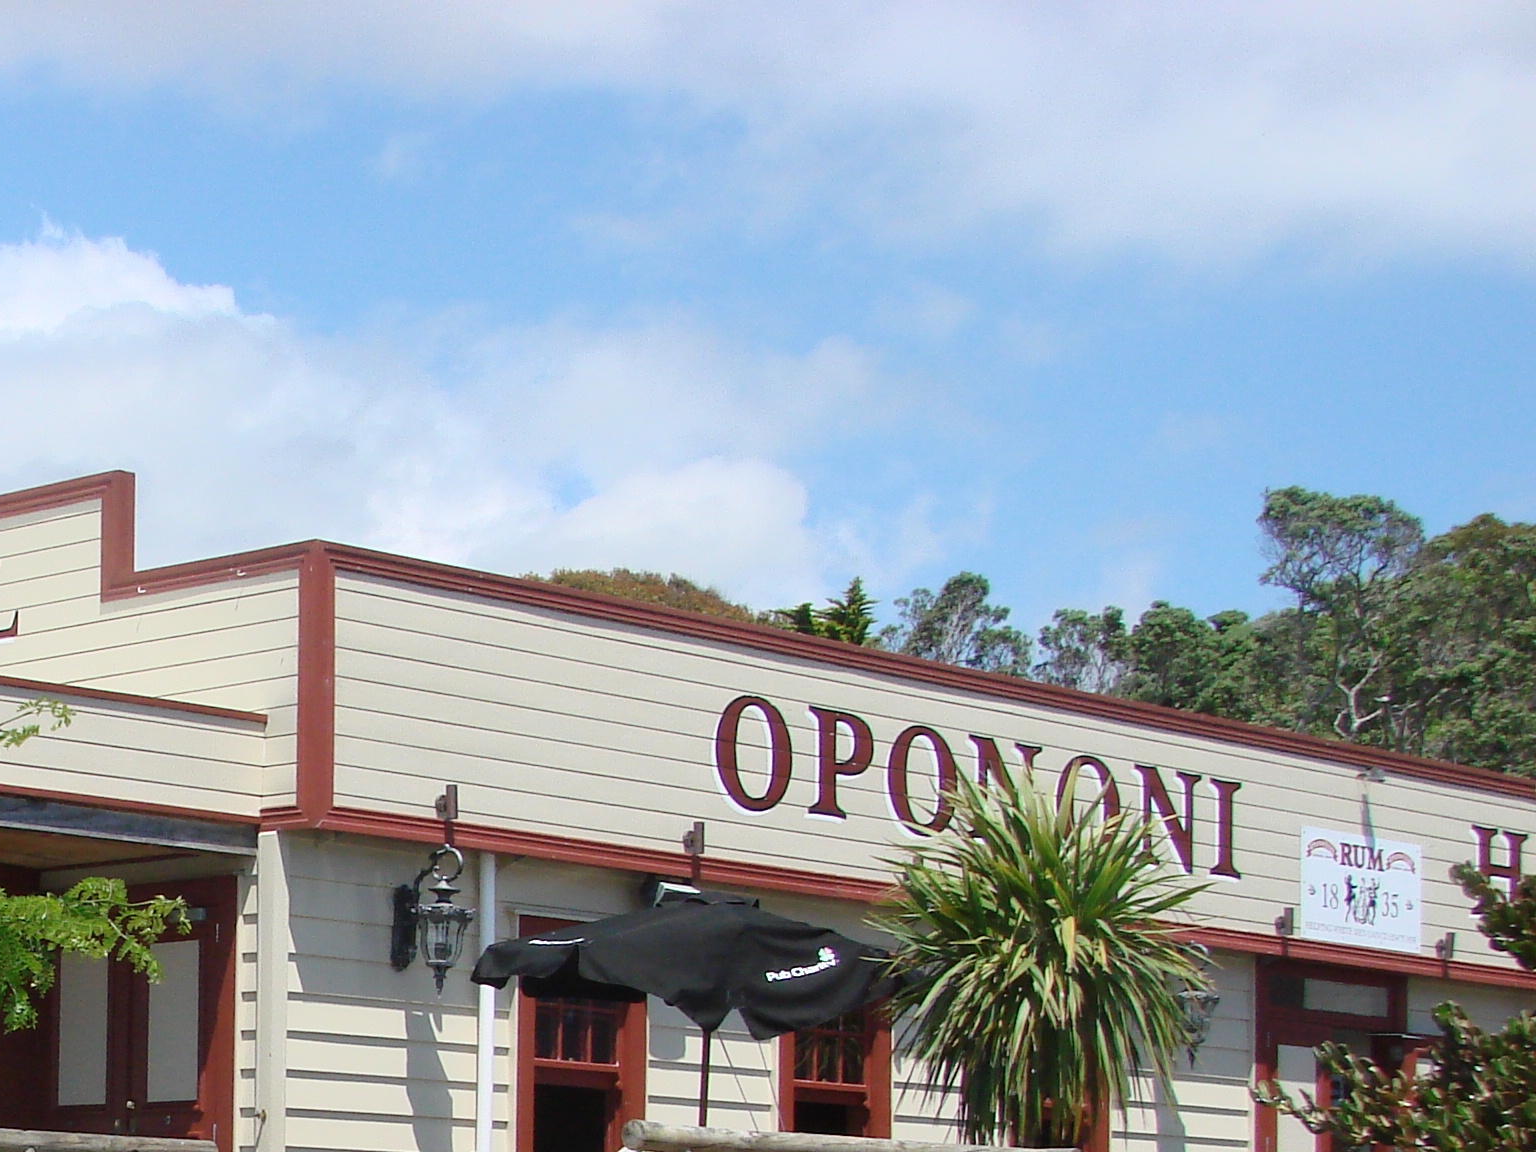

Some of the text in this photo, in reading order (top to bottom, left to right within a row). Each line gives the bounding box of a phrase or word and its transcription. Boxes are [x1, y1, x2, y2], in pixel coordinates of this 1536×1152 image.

[1339, 842, 1385, 872] RUM
[1322, 883, 1399, 918] 18 35
[765, 970, 791, 982] Pub
